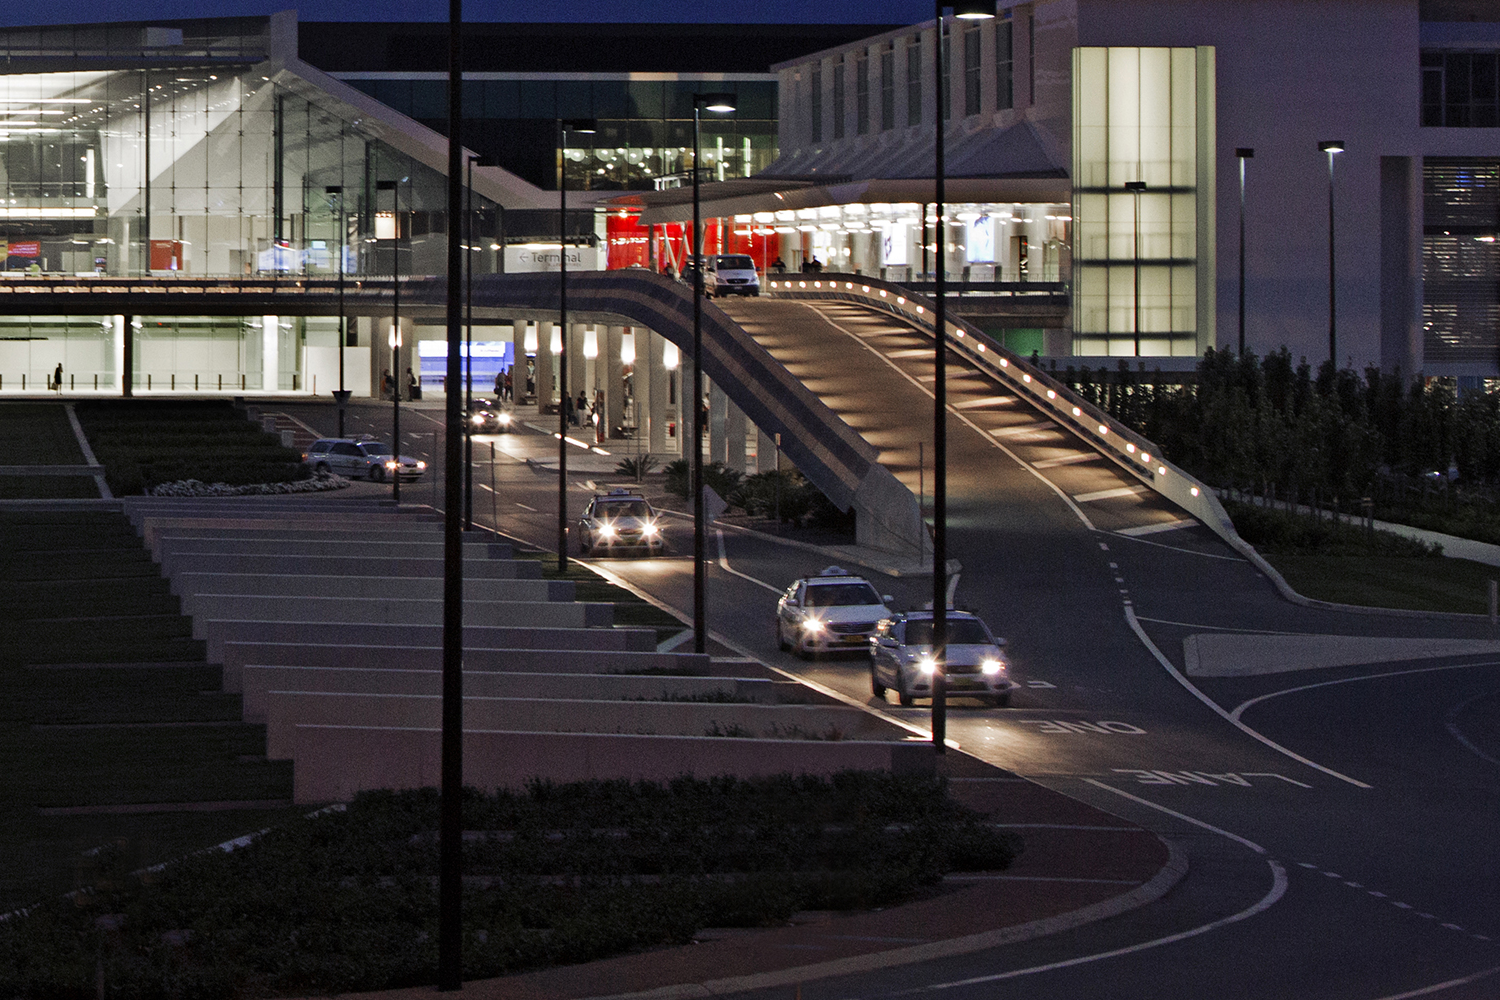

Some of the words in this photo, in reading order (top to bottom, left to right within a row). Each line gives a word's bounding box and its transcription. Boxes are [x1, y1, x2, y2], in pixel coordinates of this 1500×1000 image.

[531, 252, 581, 263] Termnal
[1018, 720, 1148, 734] ONE
[1111, 768, 1313, 788] LANE
